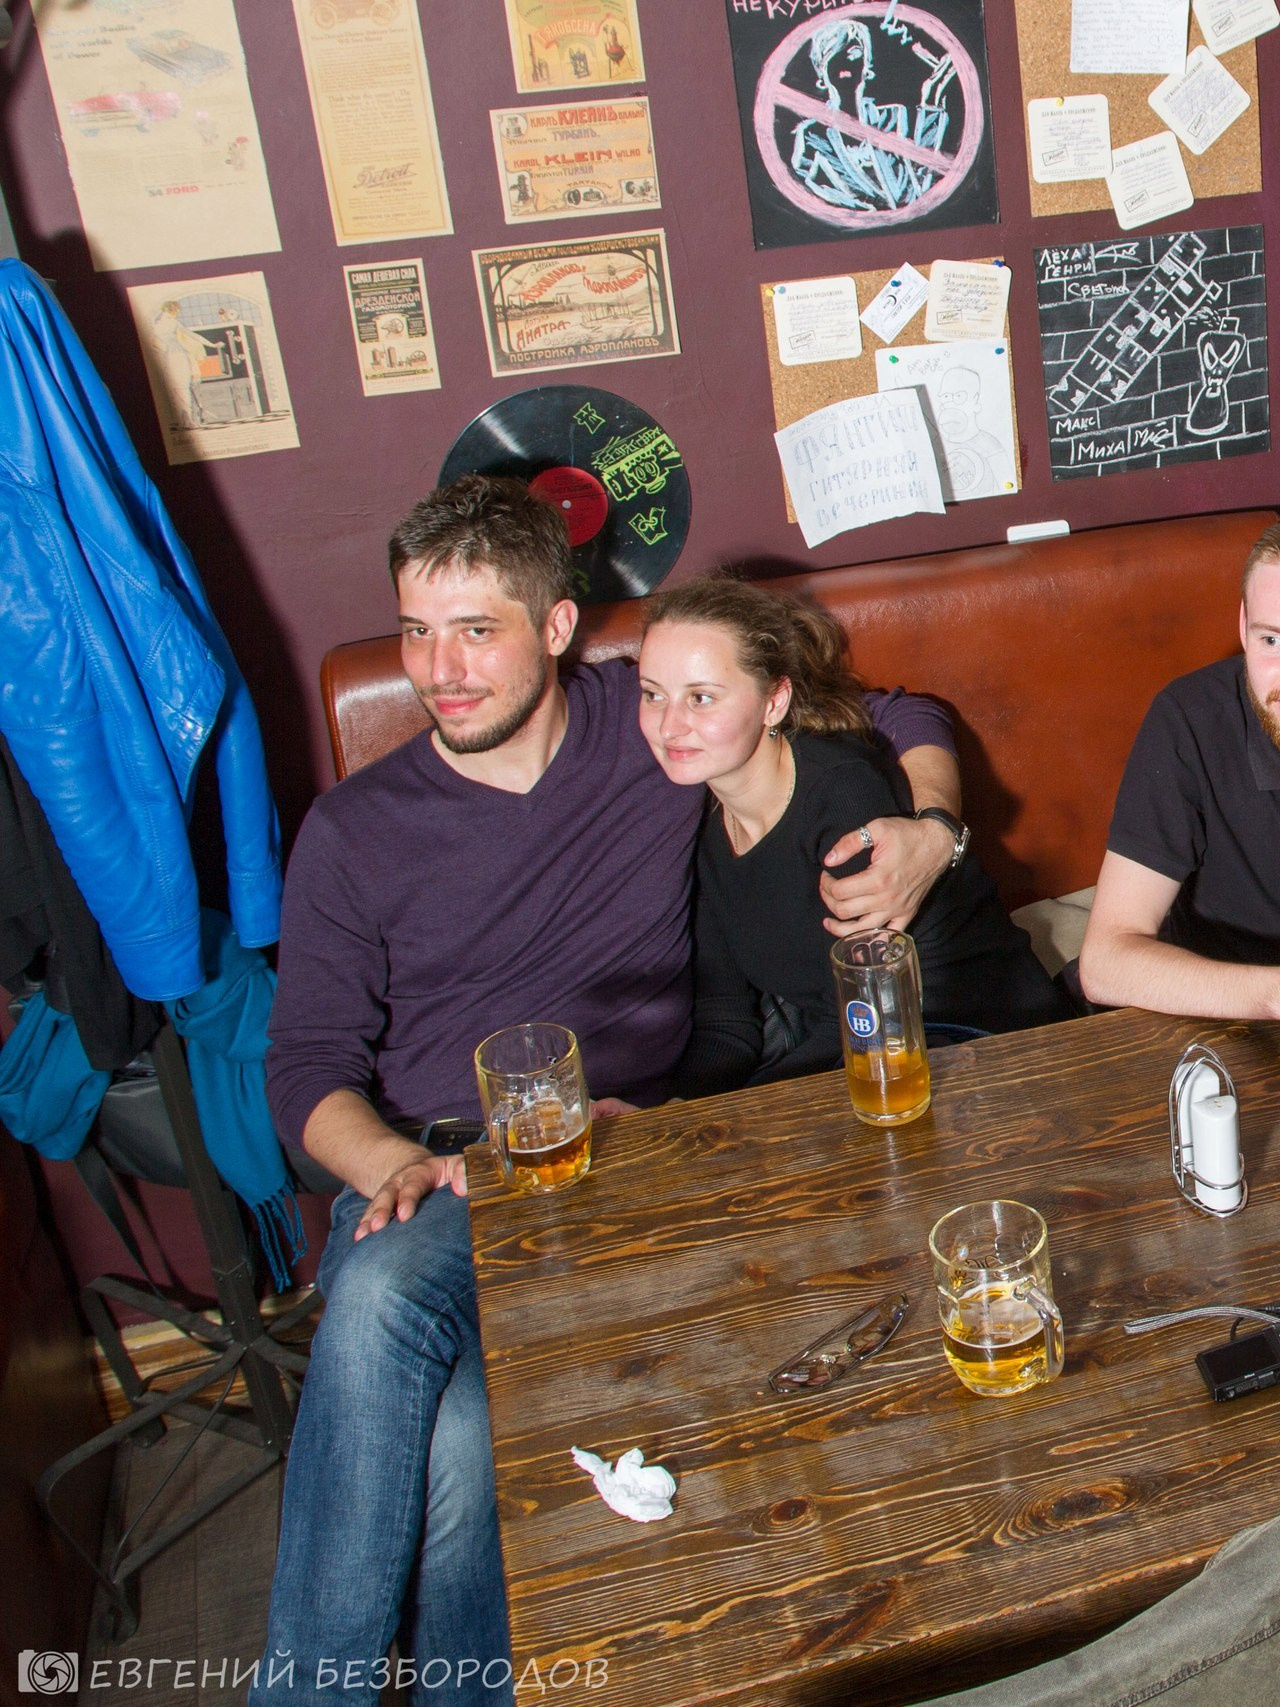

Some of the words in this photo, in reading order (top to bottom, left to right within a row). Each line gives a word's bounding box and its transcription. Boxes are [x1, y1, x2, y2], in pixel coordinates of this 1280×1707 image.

[544, 149, 613, 166] KLEIN
[166, 184, 199, 196] FORD
[1045, 260, 1093, 280] ГЕНРИ
[516, 320, 572, 350] АНАТРА
[580, 337, 660, 354] АЭРОПЛАНОВЪ
[1055, 418, 1096, 434] МАКС
[853, 1017, 871, 1032] HB
